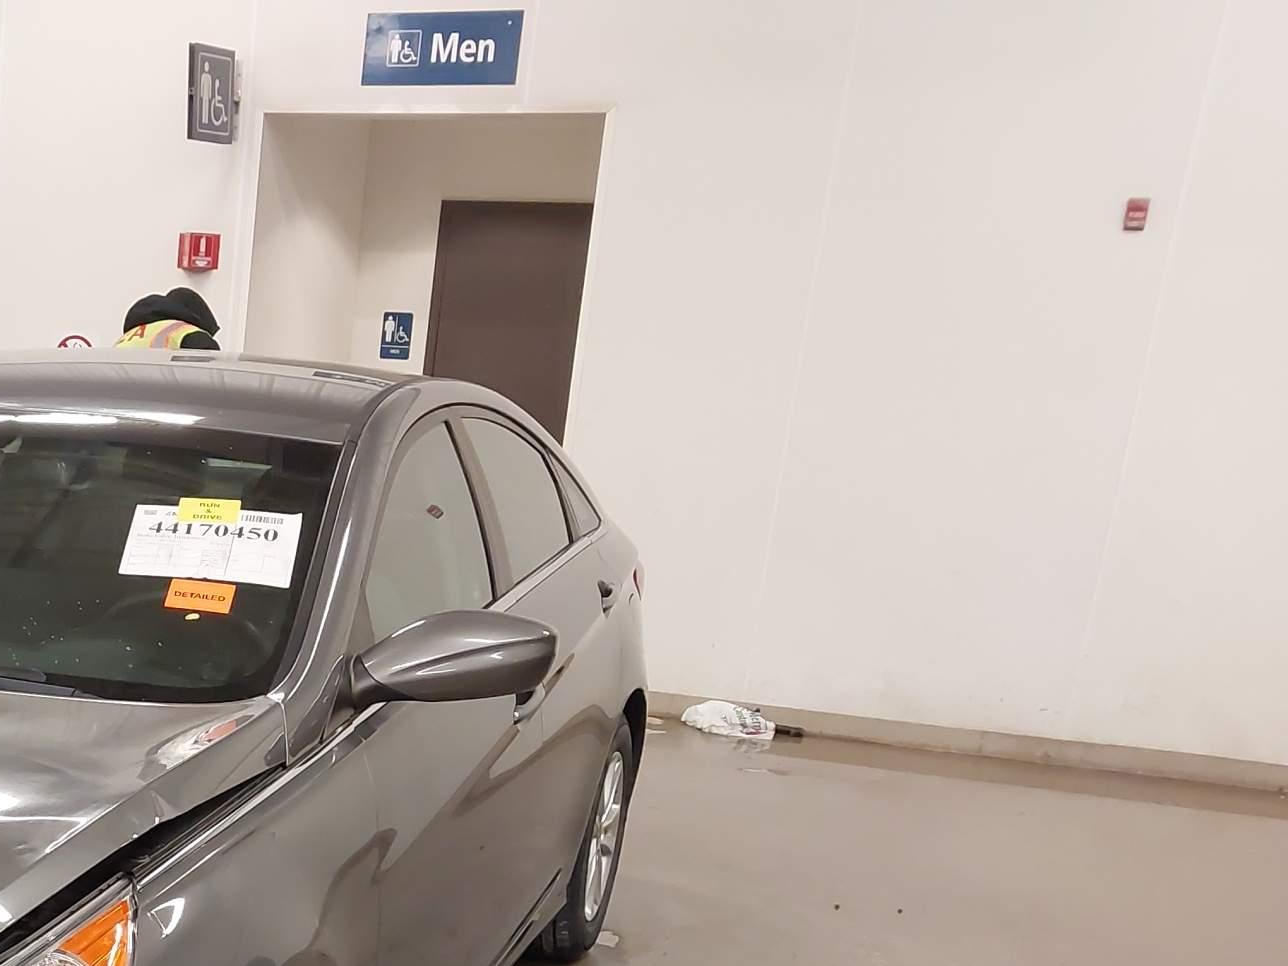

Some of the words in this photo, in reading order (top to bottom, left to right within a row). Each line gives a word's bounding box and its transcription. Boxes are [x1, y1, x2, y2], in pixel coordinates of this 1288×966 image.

[430, 32, 496, 63] Men
[148, 520, 279, 542] 44170450
[174, 589, 226, 603] DETAILED
